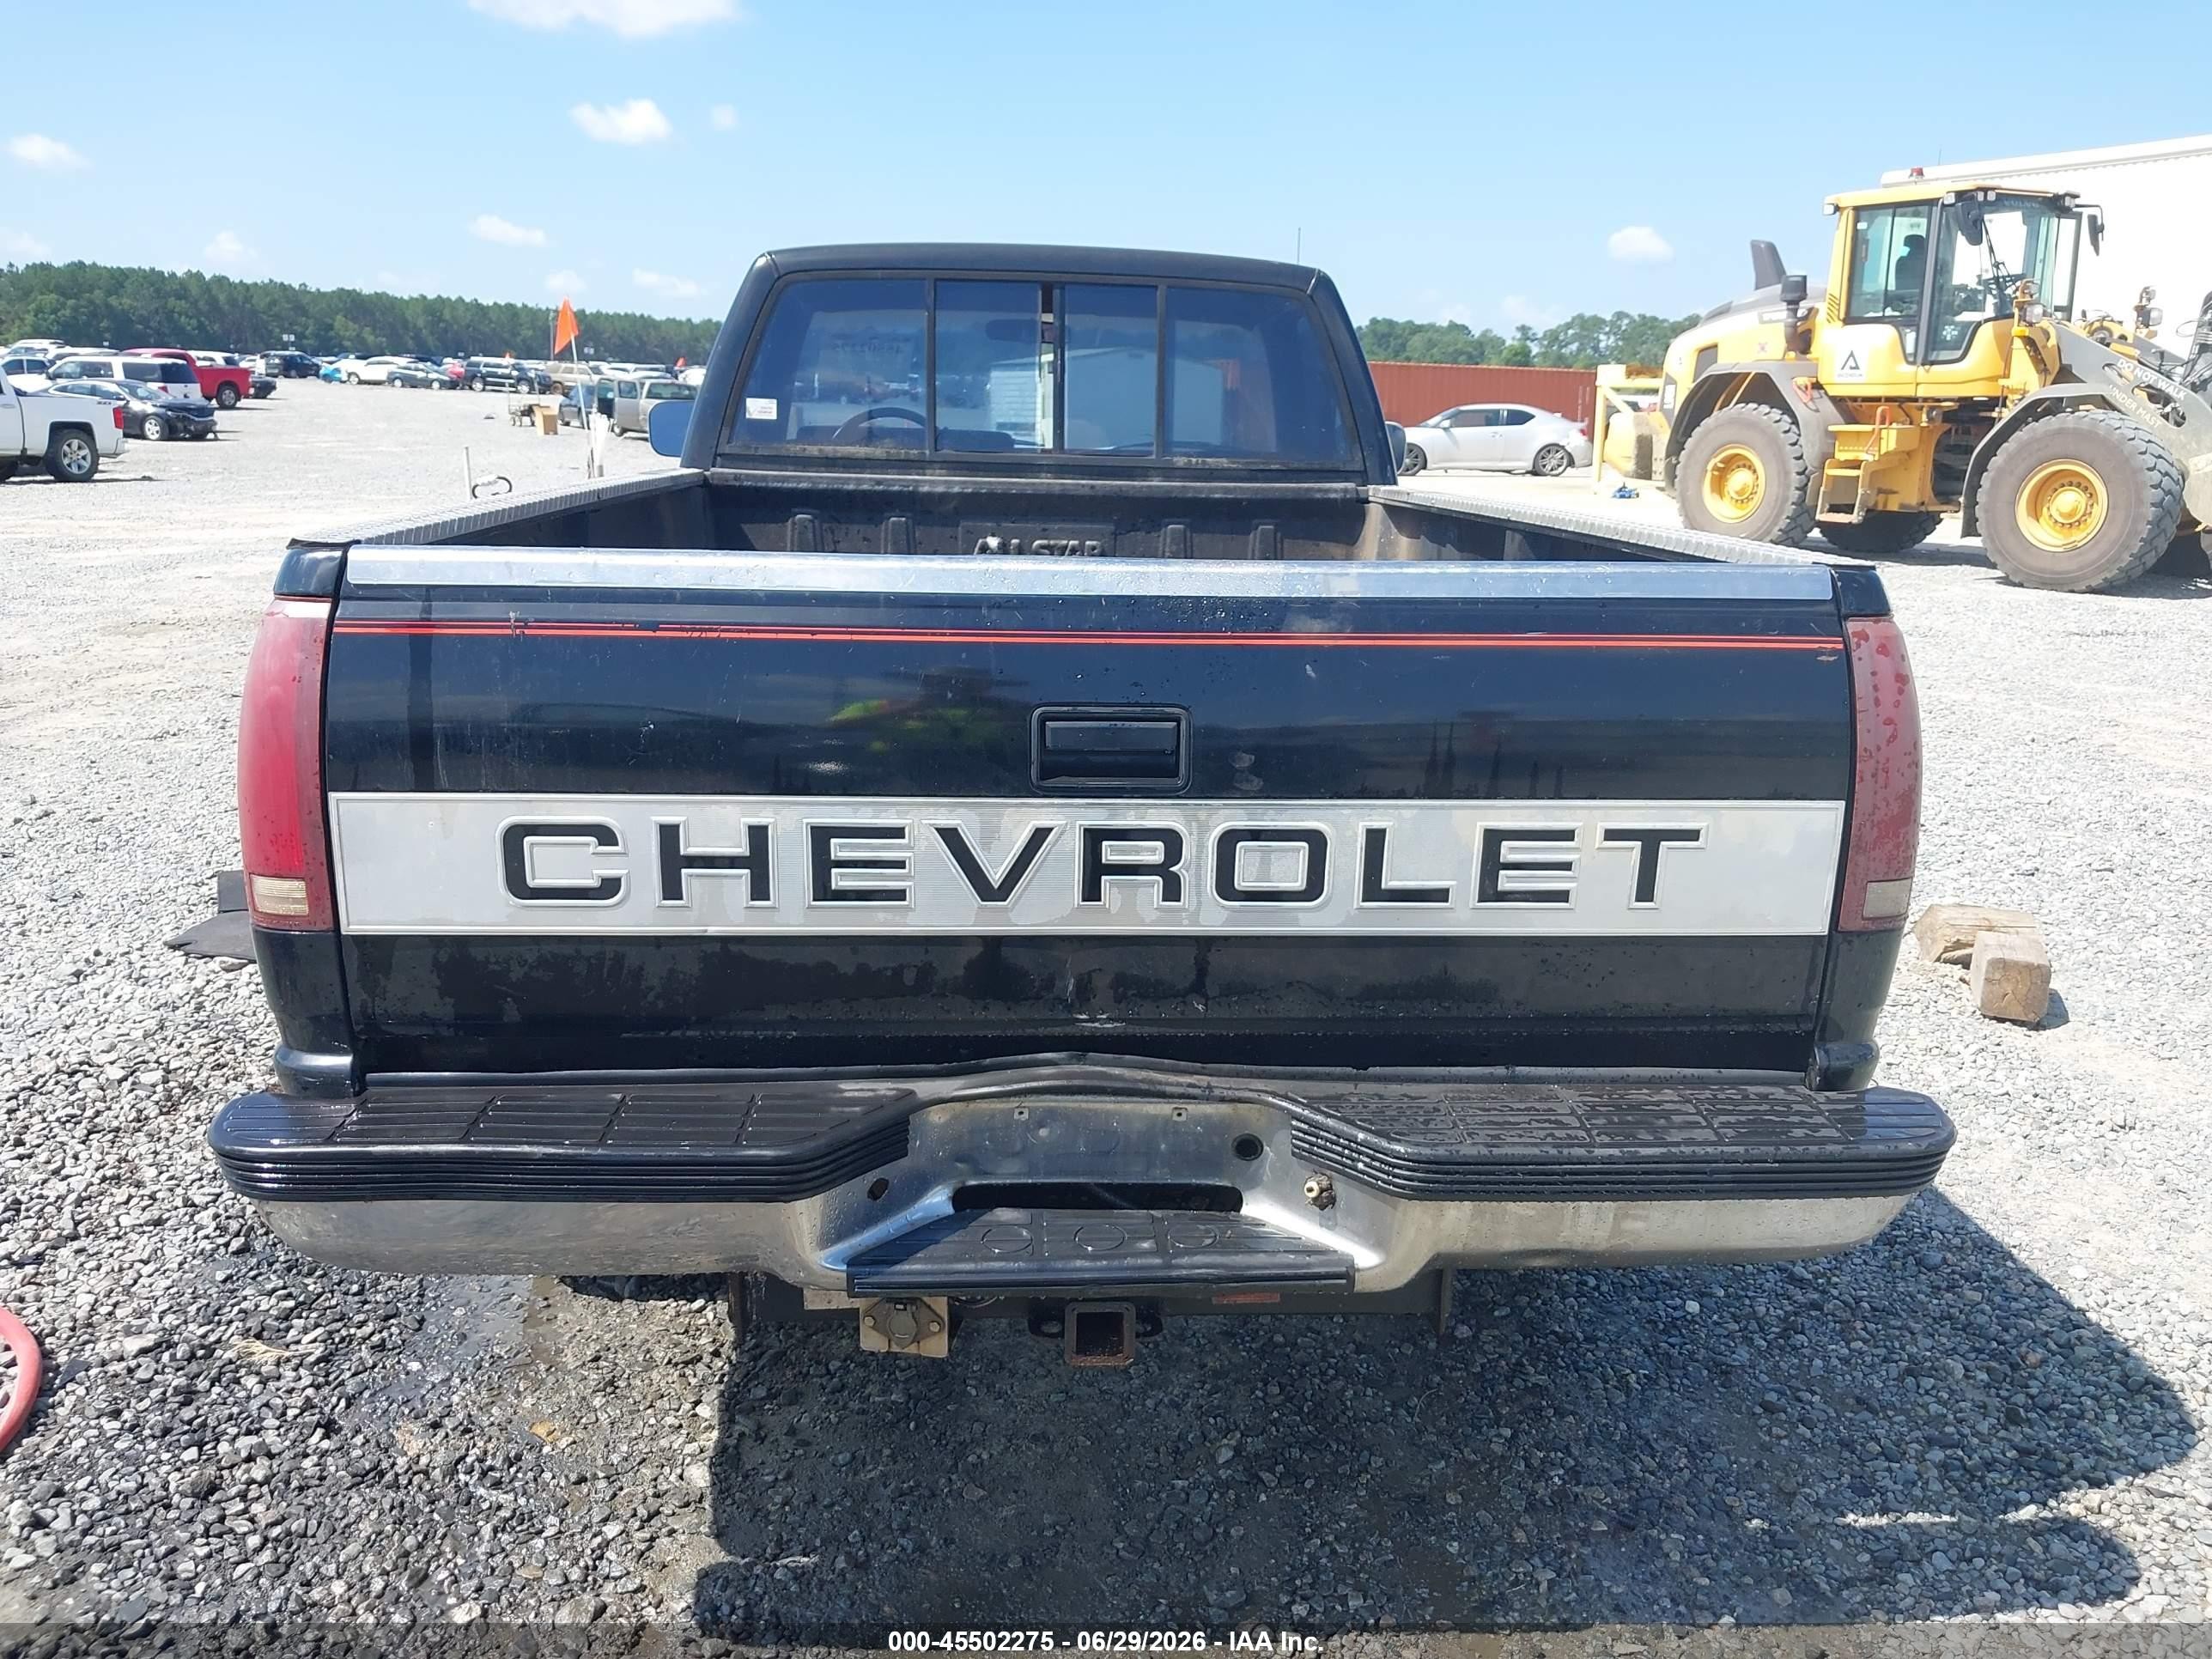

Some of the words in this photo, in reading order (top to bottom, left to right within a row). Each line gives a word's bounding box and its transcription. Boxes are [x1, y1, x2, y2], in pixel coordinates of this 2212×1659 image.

[2117, 359, 2134, 372] DO
[2134, 368, 2156, 384] NOT
[2156, 380, 2187, 401] WALK
[2136, 407, 2163, 428] MAST
[495, 815, 1710, 910] CHEVROLET
